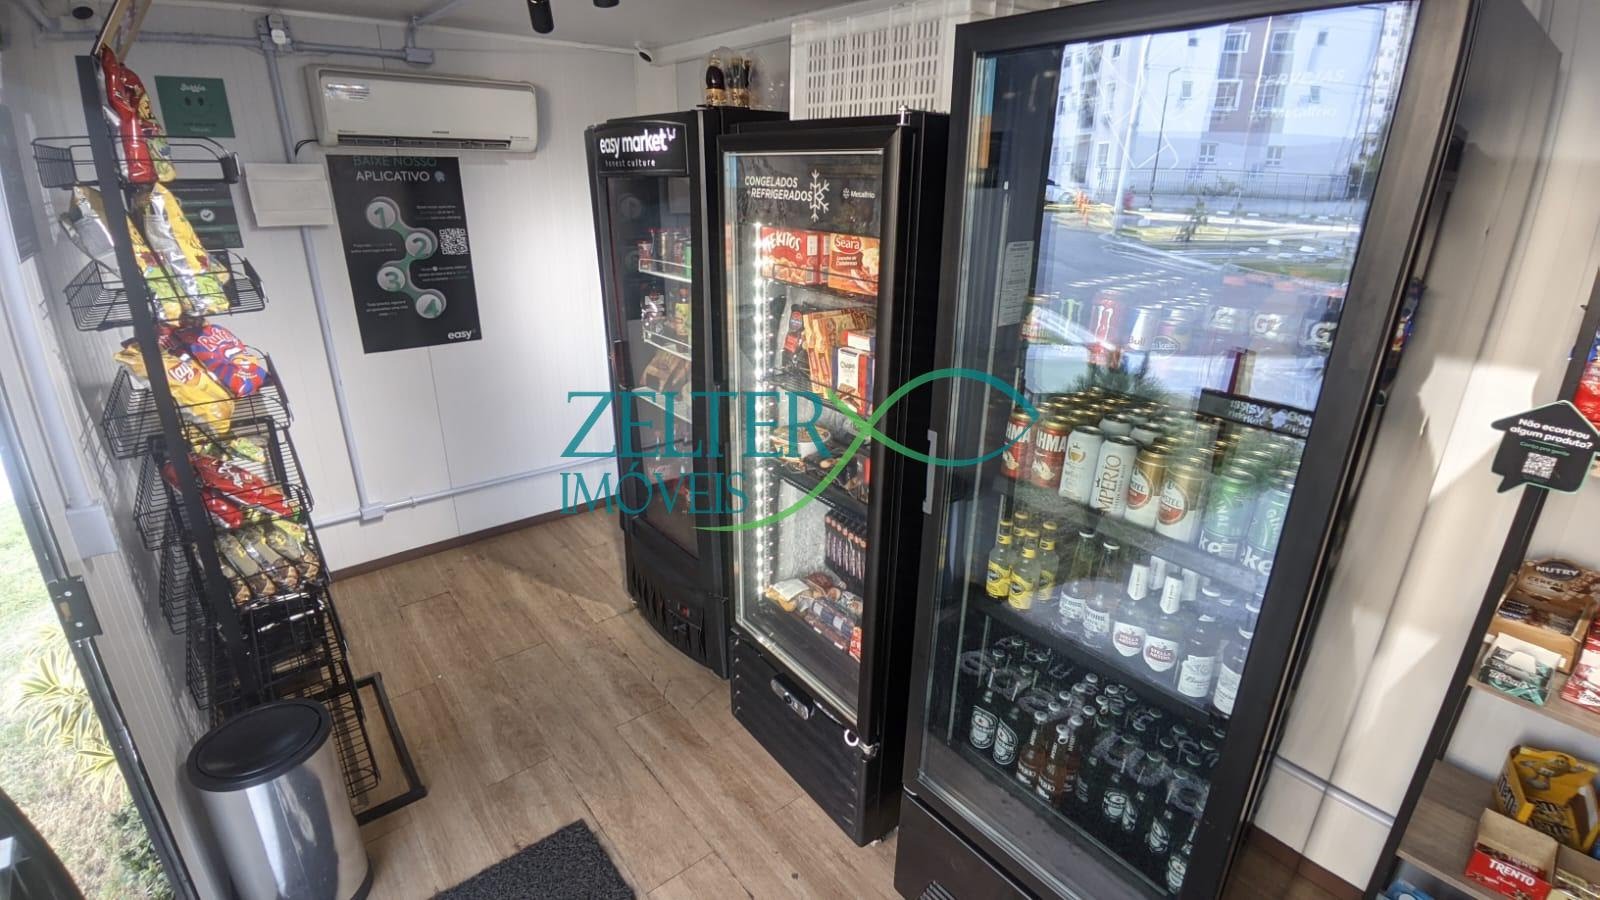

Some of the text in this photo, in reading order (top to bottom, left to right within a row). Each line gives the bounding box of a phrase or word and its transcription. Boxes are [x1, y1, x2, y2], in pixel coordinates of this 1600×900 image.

[600, 128, 668, 158] easy market
[353, 155, 438, 167] BAIXE NOSSO
[627, 159, 656, 167] culture
[356, 170, 431, 182] APLICATIVO
[745, 175, 799, 188] CONGELADOS
[751, 188, 813, 202] REFRIGERADOS
[836, 238, 860, 250] Seara
[198, 328, 239, 352] Ruff
[447, 330, 473, 341] easy
[1519, 418, 1591, 440] Não econtrou
[1510, 426, 1593, 450] algum produto?
[1535, 565, 1580, 577] NUTRY
[1527, 576, 1565, 588] CEREAL
[1488, 858, 1536, 887] TRENTO
